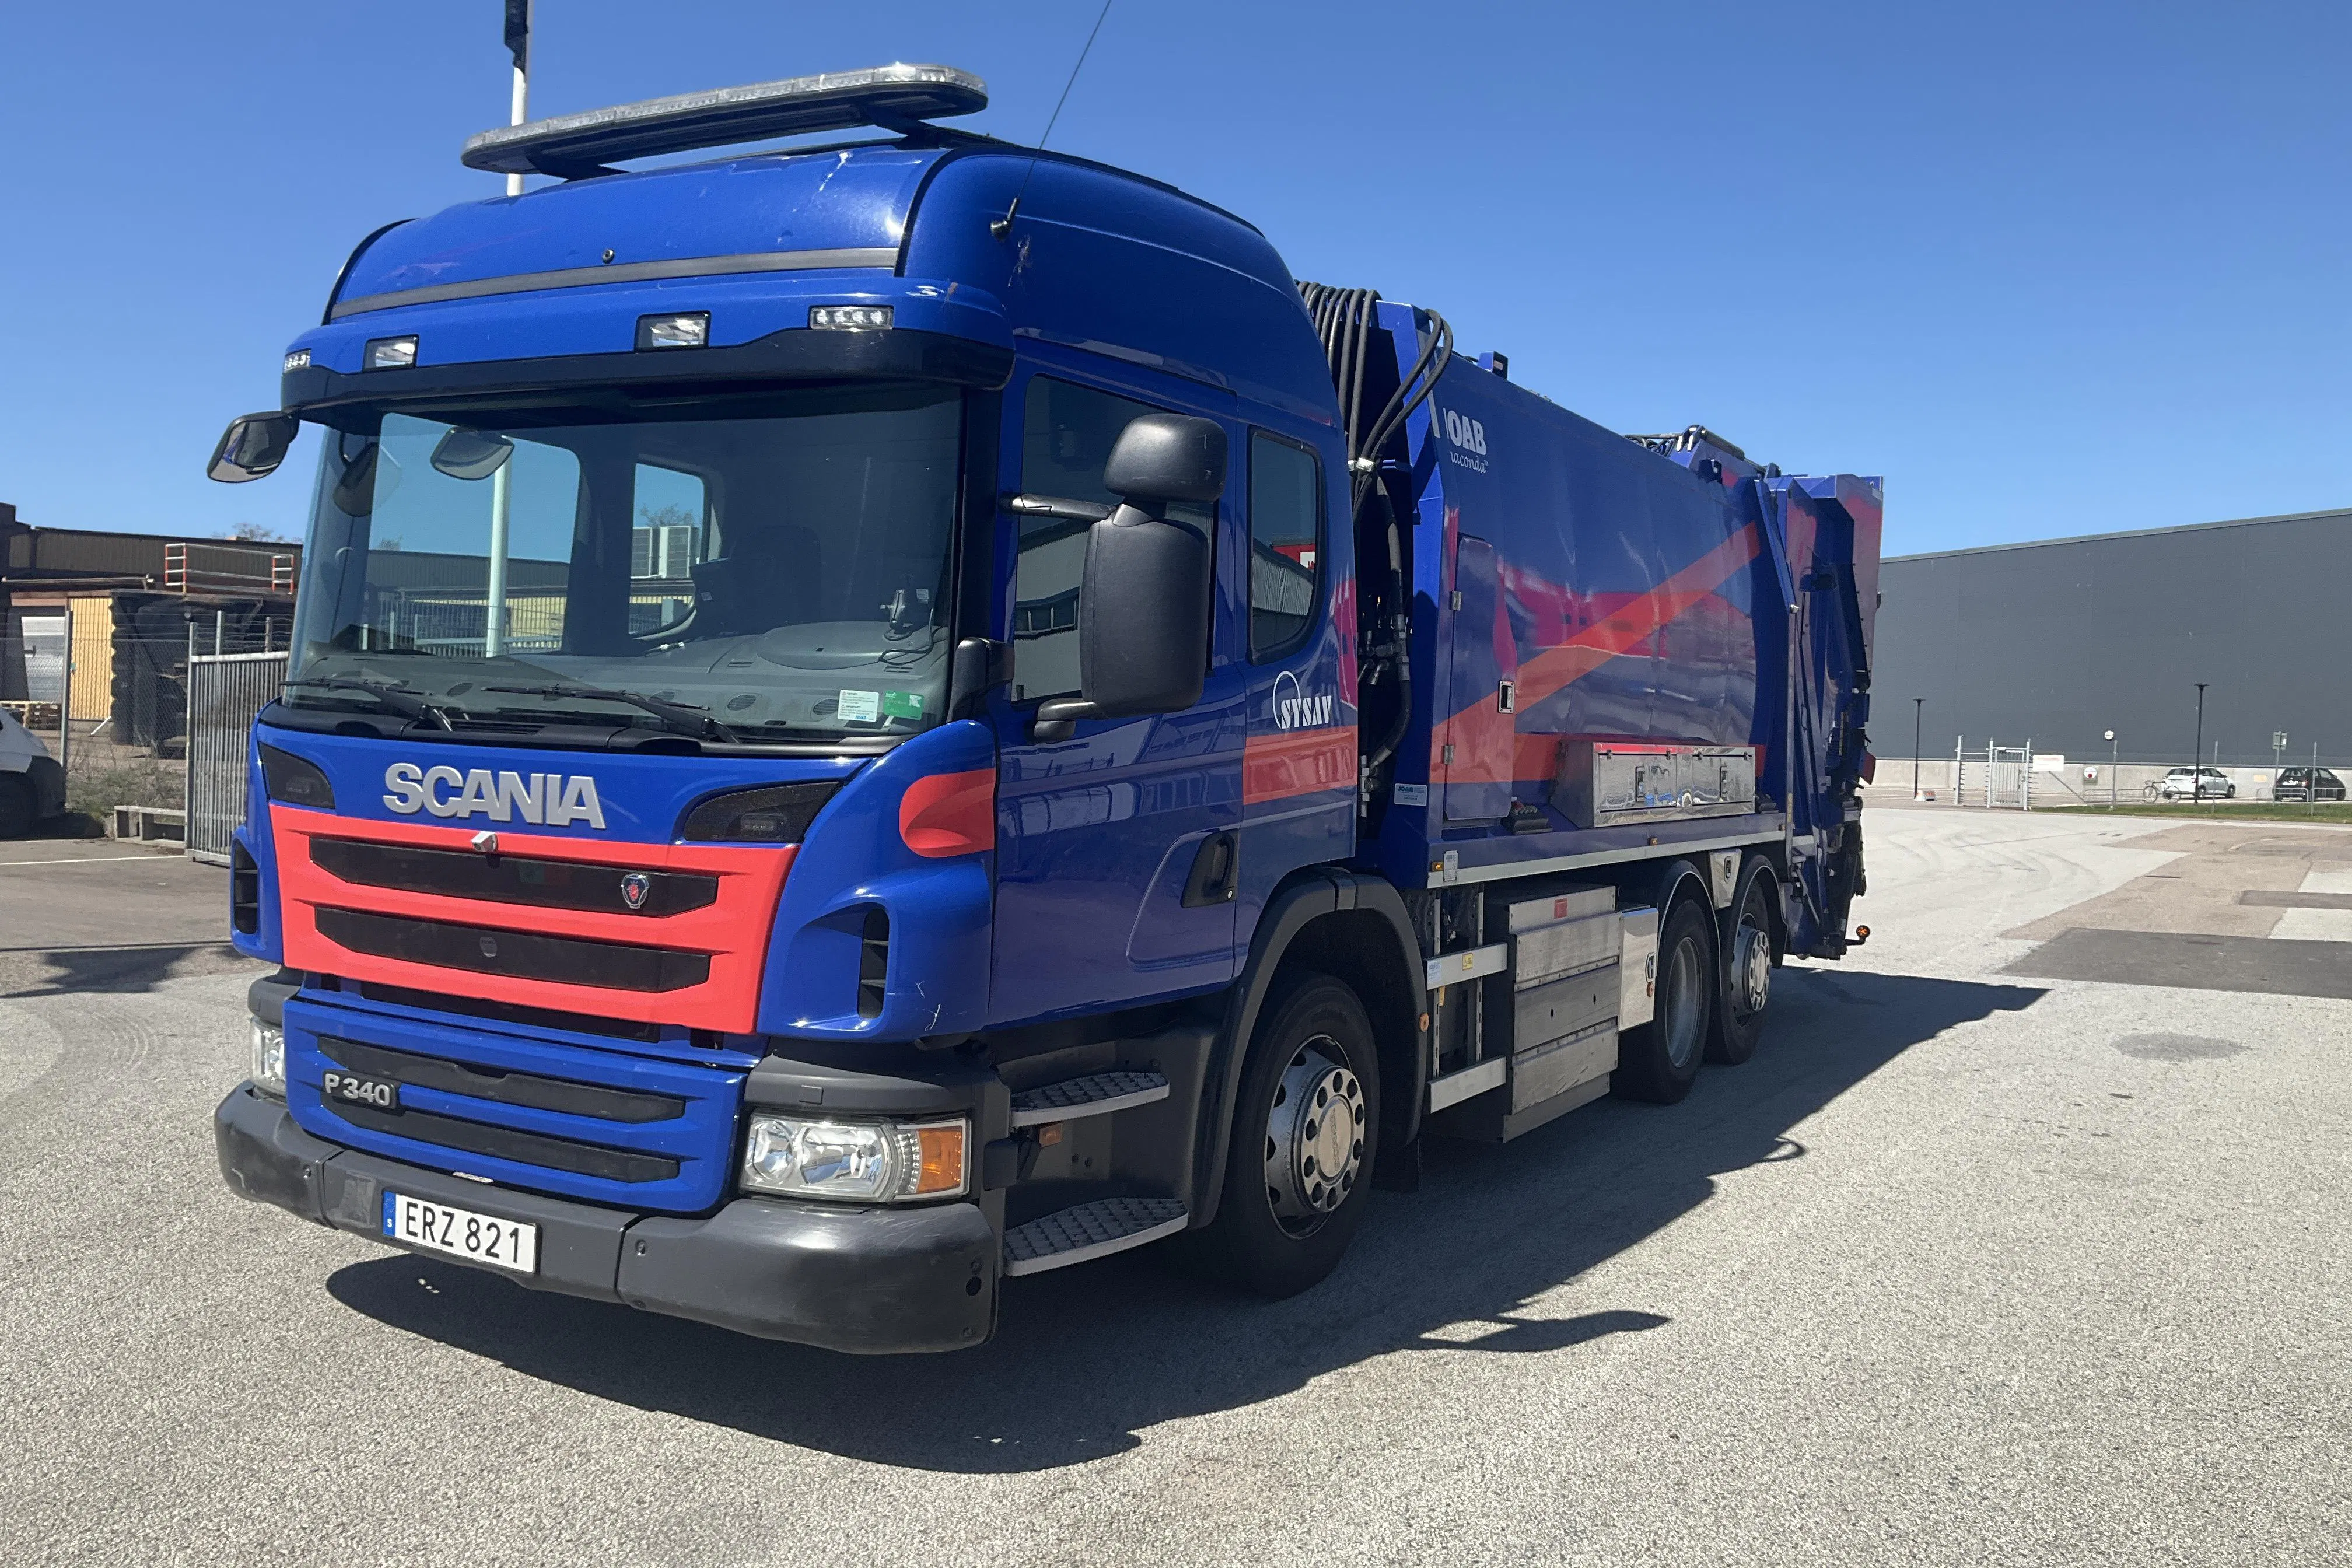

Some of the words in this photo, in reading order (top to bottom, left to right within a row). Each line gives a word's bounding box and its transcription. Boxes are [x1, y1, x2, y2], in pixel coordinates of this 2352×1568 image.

[1280, 695, 1332, 729] SYSAV
[383, 762, 607, 830] SCANIA
[325, 1073, 339, 1094] P
[343, 1077, 390, 1106] 340
[387, 1218, 393, 1228] S
[406, 1201, 455, 1247] ERZ
[466, 1217, 519, 1263] 821
